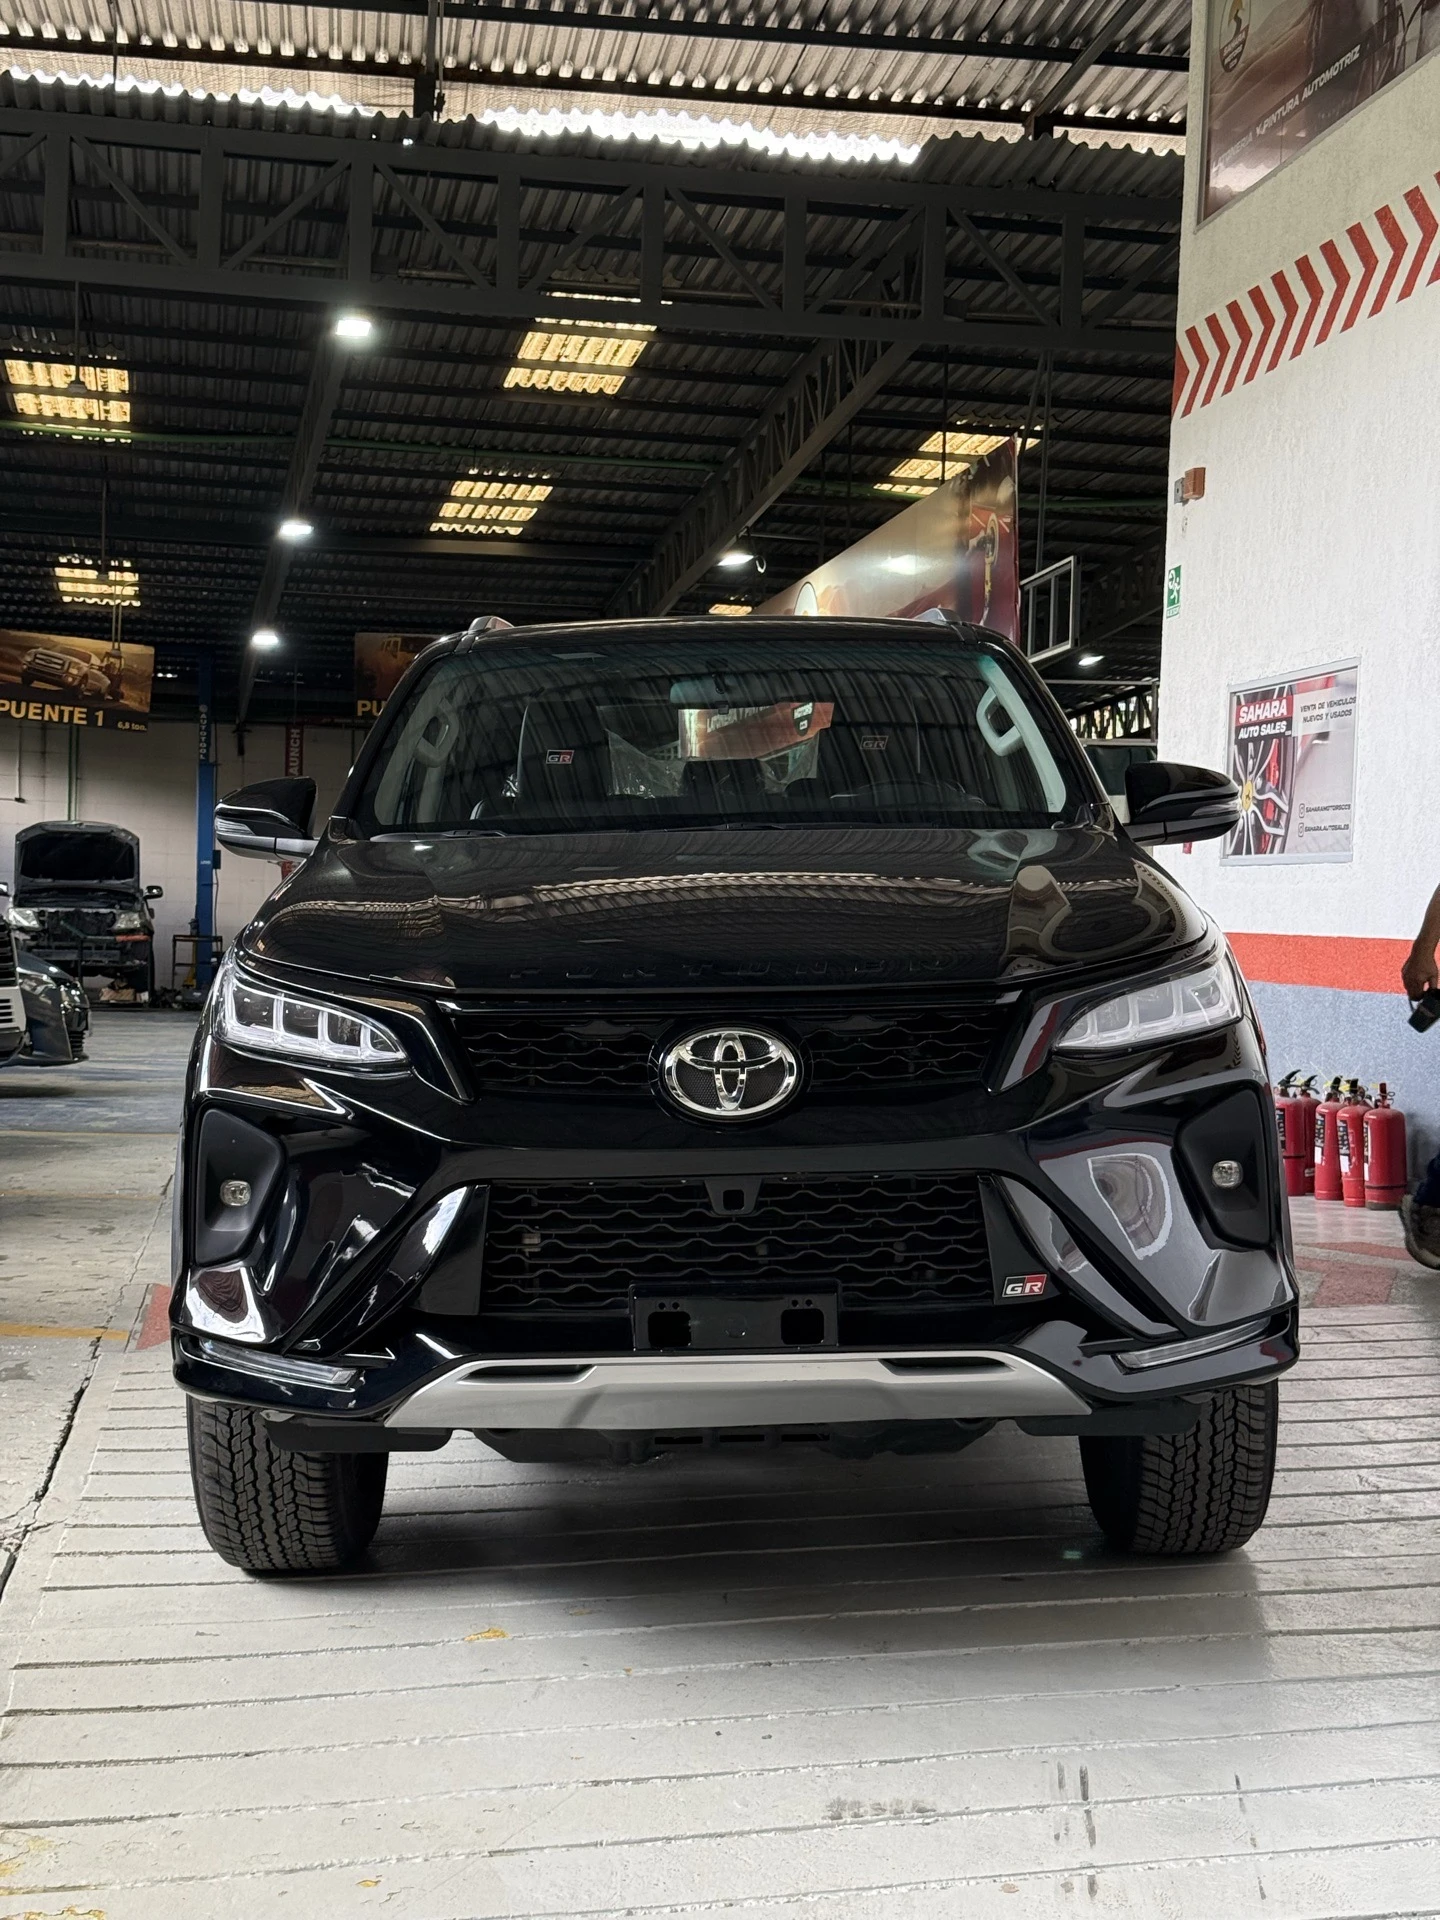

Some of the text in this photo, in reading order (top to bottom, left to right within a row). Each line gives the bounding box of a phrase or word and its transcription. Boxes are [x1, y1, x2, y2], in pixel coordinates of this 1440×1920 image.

[1262, 94, 1300, 134] PINTURA
[1301, 44, 1361, 101] AUTOMOTRIZ
[1239, 699, 1287, 723] SAHARA
[1300, 703, 1316, 713] VENTA
[1318, 701, 1325, 710] DE
[95, 710, 104, 726] 1
[1303, 713, 1323, 723] NUEVOS
[1330, 709, 1352, 719] USADOS
[1238, 720, 1287, 739] AUTO SALES
[289, 728, 301, 776] AUNCH
[1005, 1280, 1043, 1296] GR
